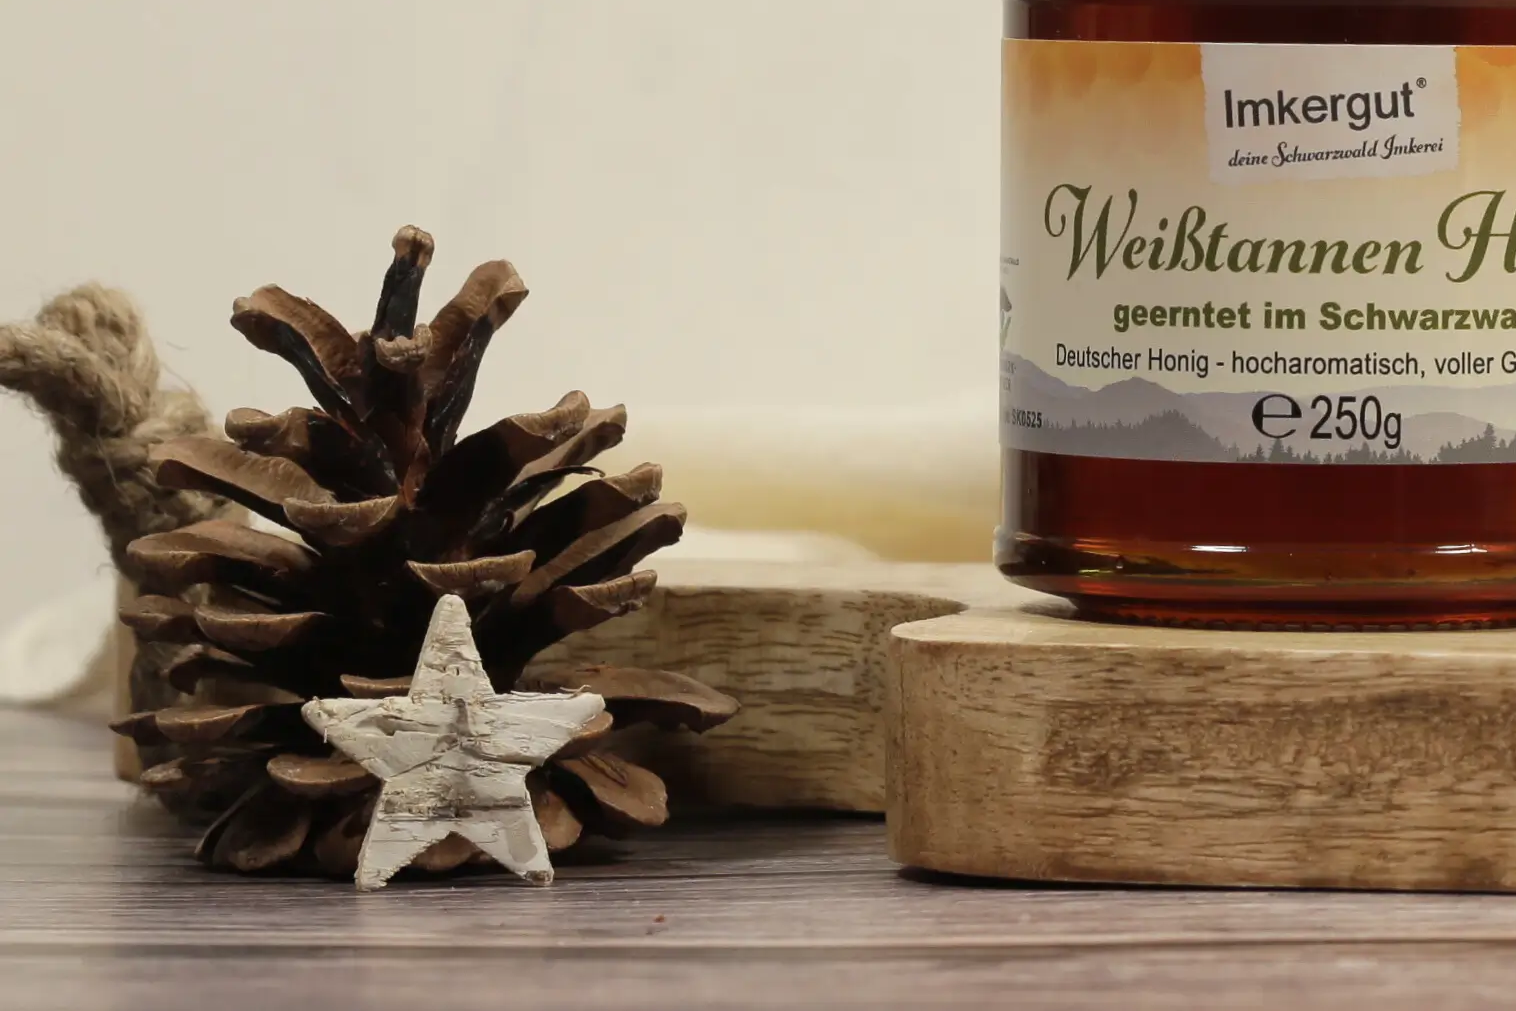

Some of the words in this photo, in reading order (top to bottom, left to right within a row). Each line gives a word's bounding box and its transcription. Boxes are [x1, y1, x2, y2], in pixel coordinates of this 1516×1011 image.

[1227, 149, 1269, 168] deine
[1271, 139, 1378, 167] Schwarzwald
[1380, 135, 1443, 160] Imkerei
[1044, 183, 1424, 282] Weißtannen
[1113, 303, 1251, 333] geerntet
[1263, 302, 1305, 330] im
[1055, 343, 1141, 373] Deutscher
[1148, 348, 1209, 379] Honig
[1231, 350, 1426, 378] hocharomatisch,
[1434, 346, 1493, 376] voller
[1012, 409, 1042, 428] SK0525
[1310, 395, 1402, 449] 250g
